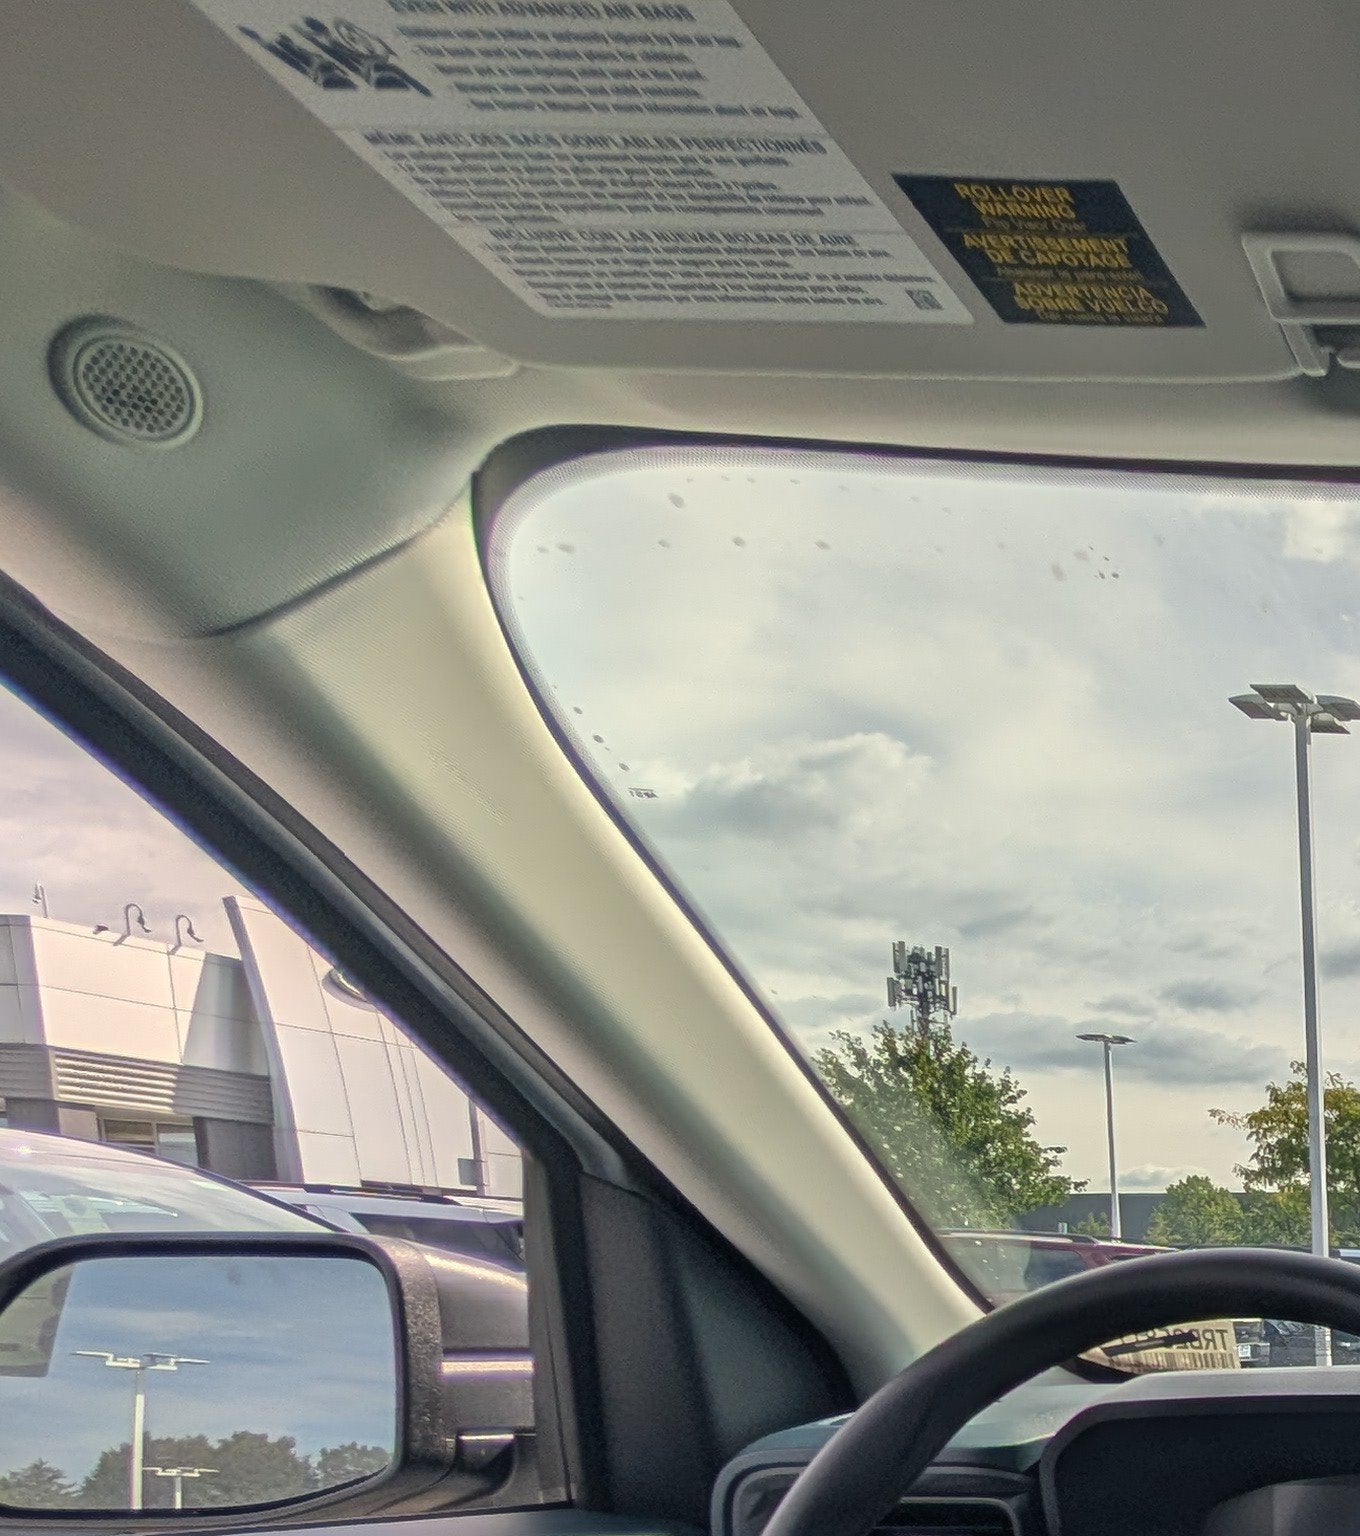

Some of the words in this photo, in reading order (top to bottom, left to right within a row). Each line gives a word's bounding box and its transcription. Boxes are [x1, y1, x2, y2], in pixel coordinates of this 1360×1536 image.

[954, 183, 1075, 204] ROLLOVER
[972, 200, 1076, 219] WARNING
[986, 250, 1018, 265] DE
[1021, 251, 1132, 269] CAPOTAGE
